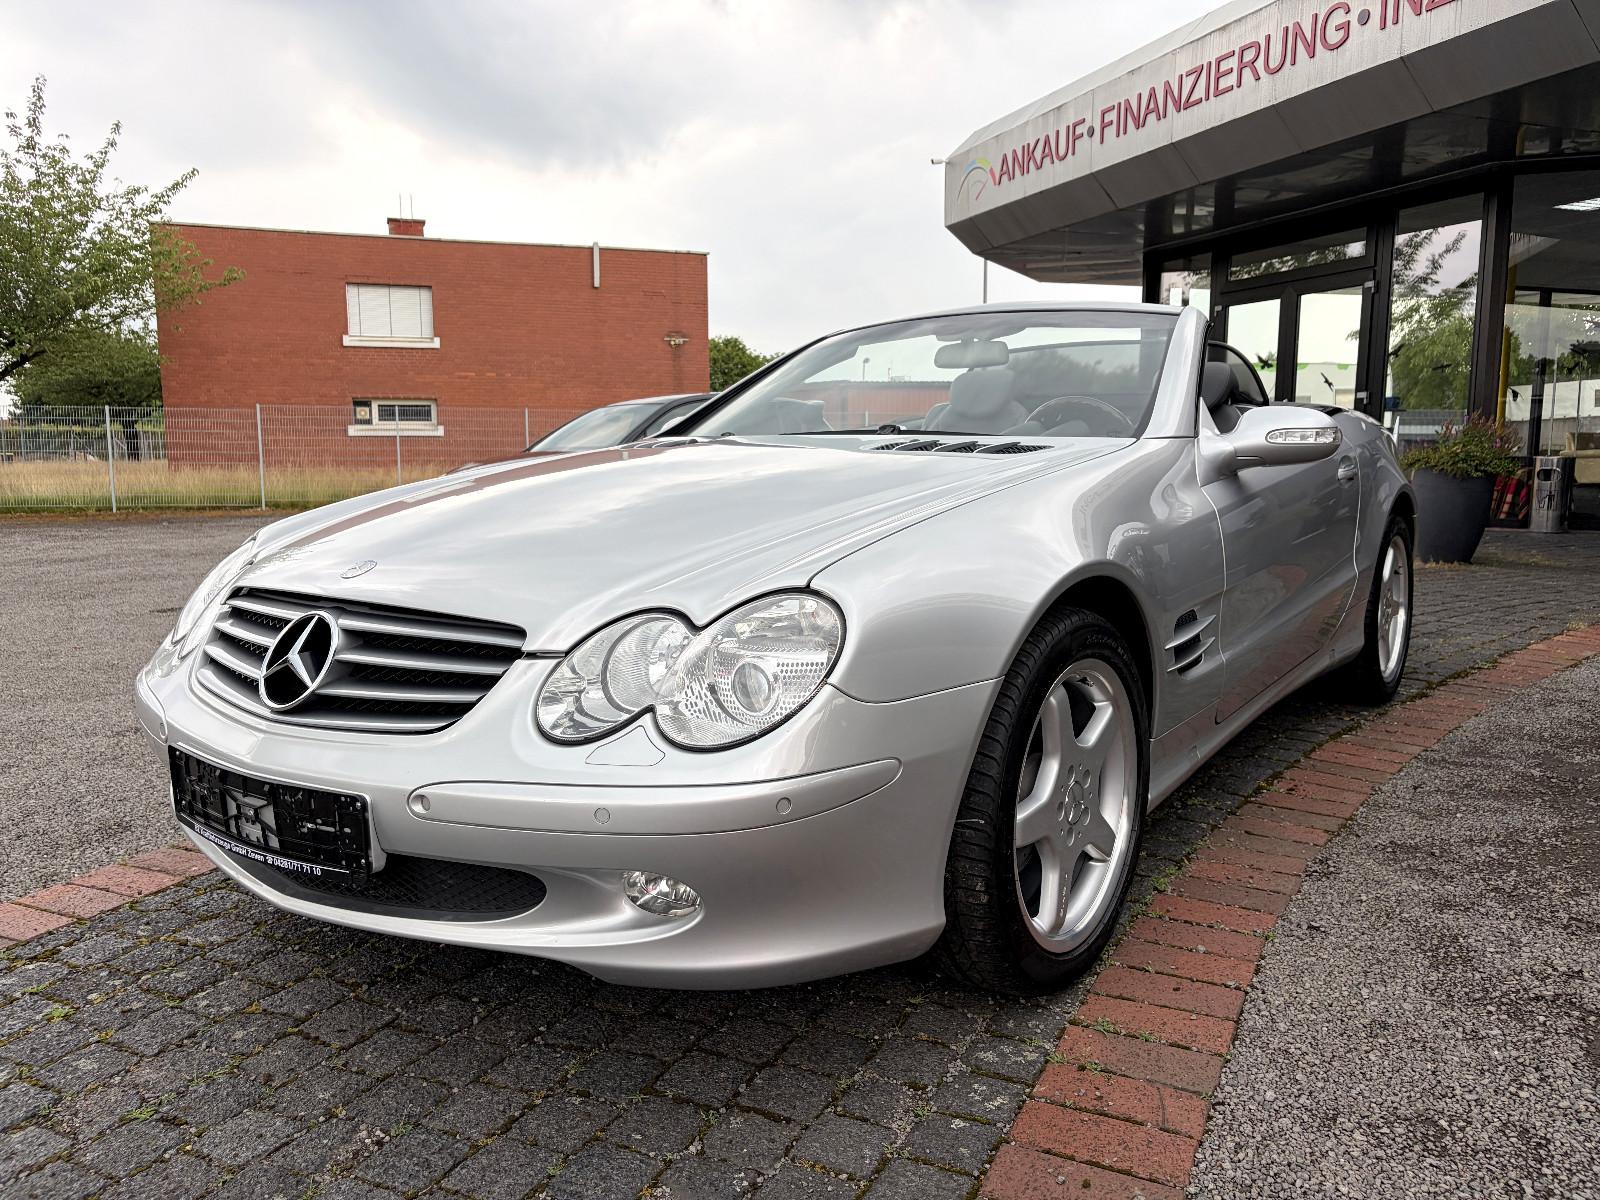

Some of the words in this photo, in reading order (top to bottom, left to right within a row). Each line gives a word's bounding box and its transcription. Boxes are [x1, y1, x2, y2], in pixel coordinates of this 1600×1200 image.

[998, 117, 1086, 186] ANKAUF
[1099, 1, 1352, 145] FINANZIERUNG
[230, 843, 247, 856] GmbH
[302, 863, 311, 874] 71
[312, 866, 322, 876] 10
